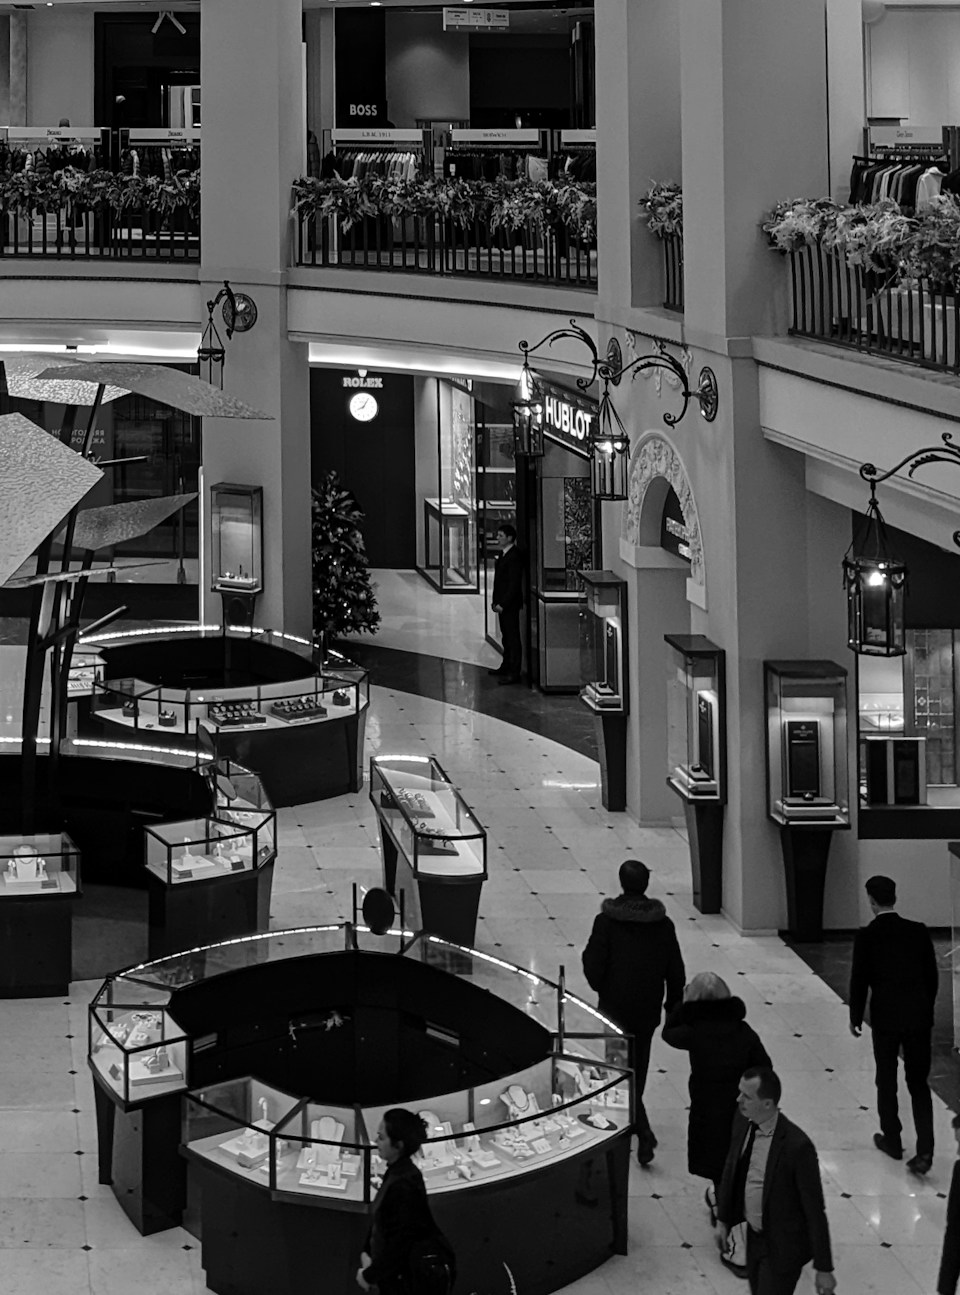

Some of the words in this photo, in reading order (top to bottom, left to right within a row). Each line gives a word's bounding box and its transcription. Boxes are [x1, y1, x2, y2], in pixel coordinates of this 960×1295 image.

[349, 103, 377, 116] BOSS
[343, 377, 383, 388] ROLEX
[545, 395, 592, 442] HUBLOT
